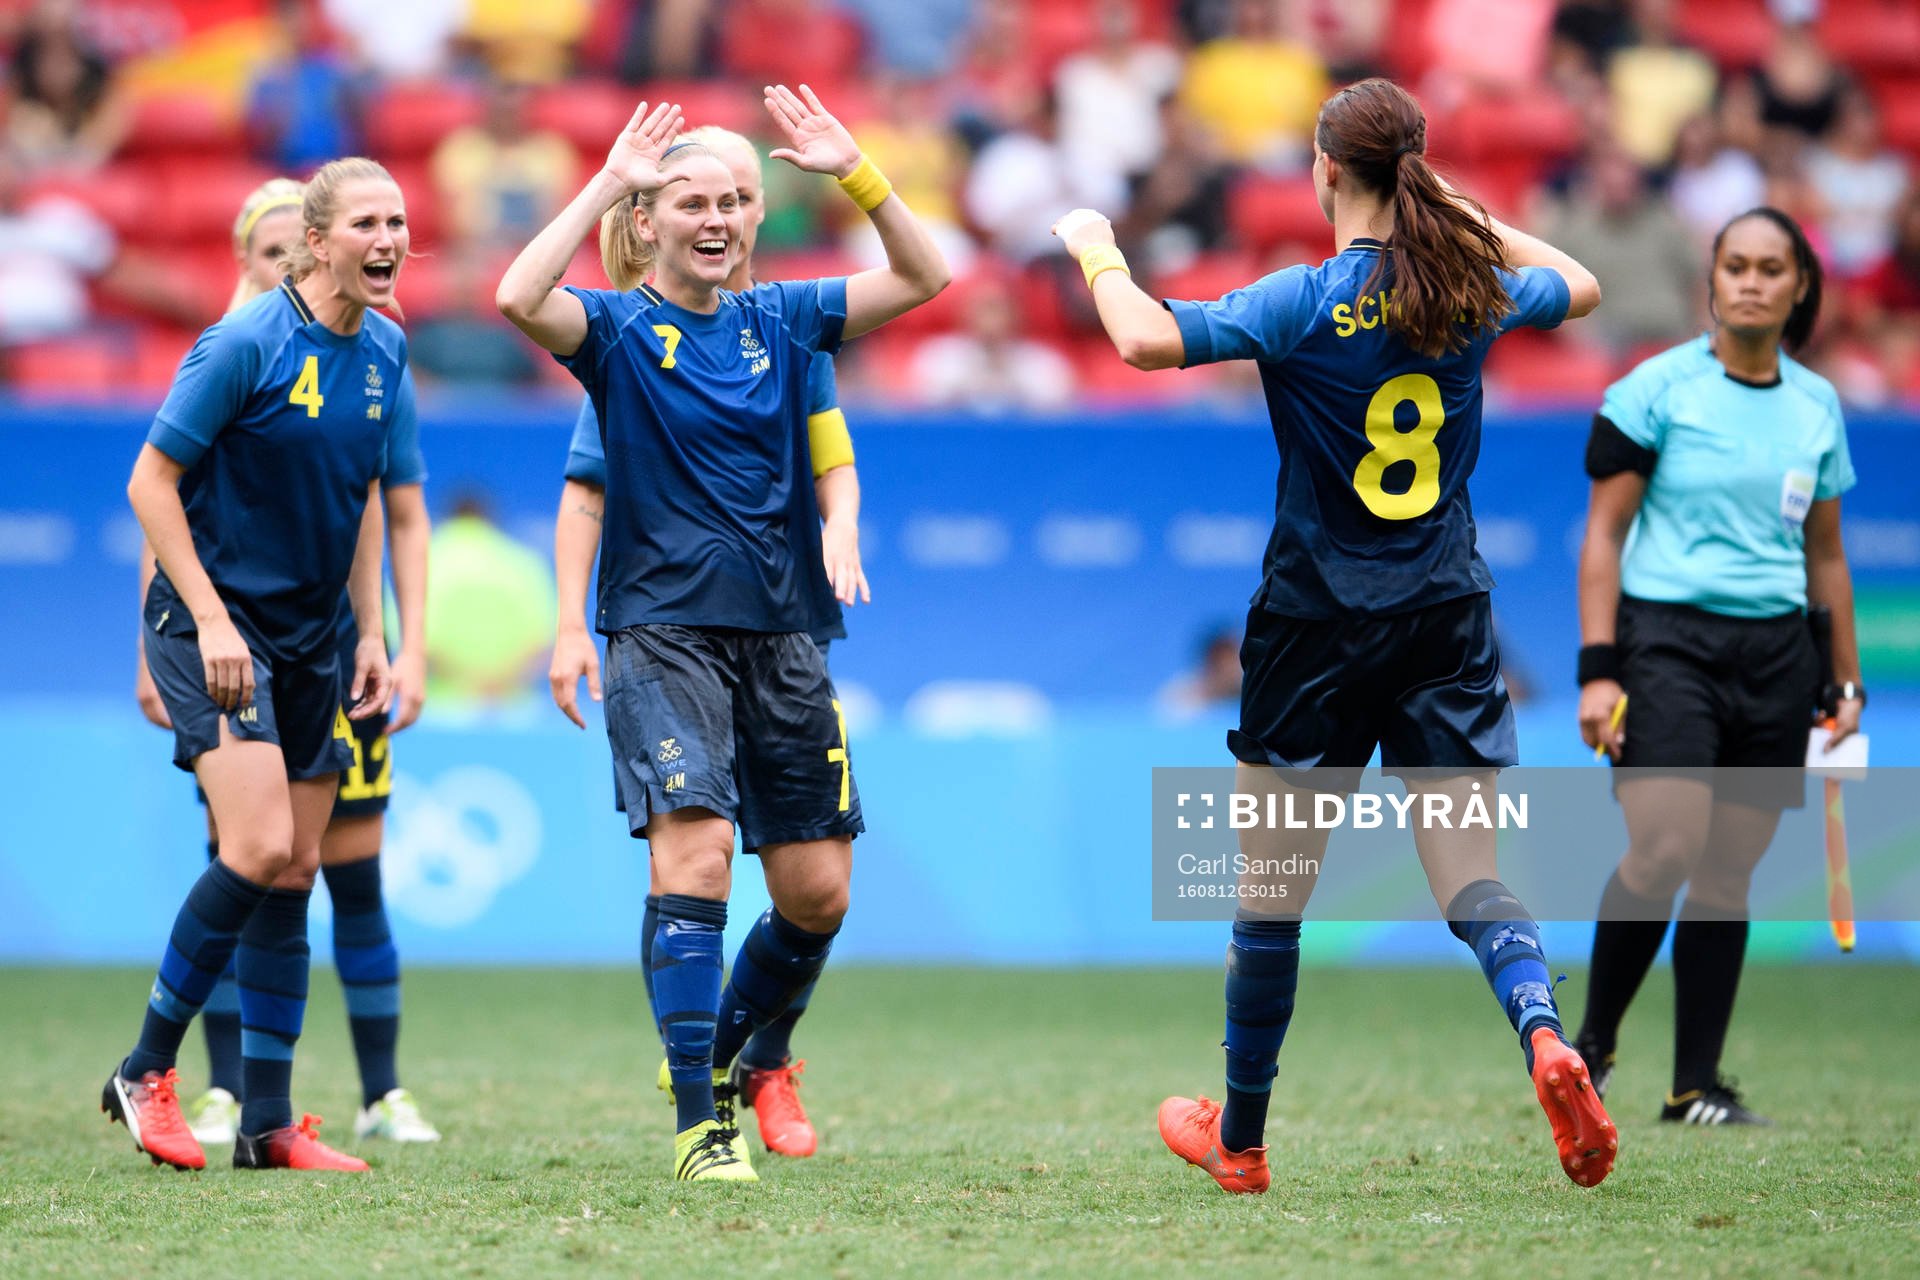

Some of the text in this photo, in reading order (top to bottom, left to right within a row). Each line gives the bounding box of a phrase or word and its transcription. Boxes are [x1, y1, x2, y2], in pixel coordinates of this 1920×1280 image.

[652, 324, 682, 369] 7
[741, 347, 767, 359] SWE
[289, 355, 324, 418] 4
[1353, 373, 1445, 521] 8
